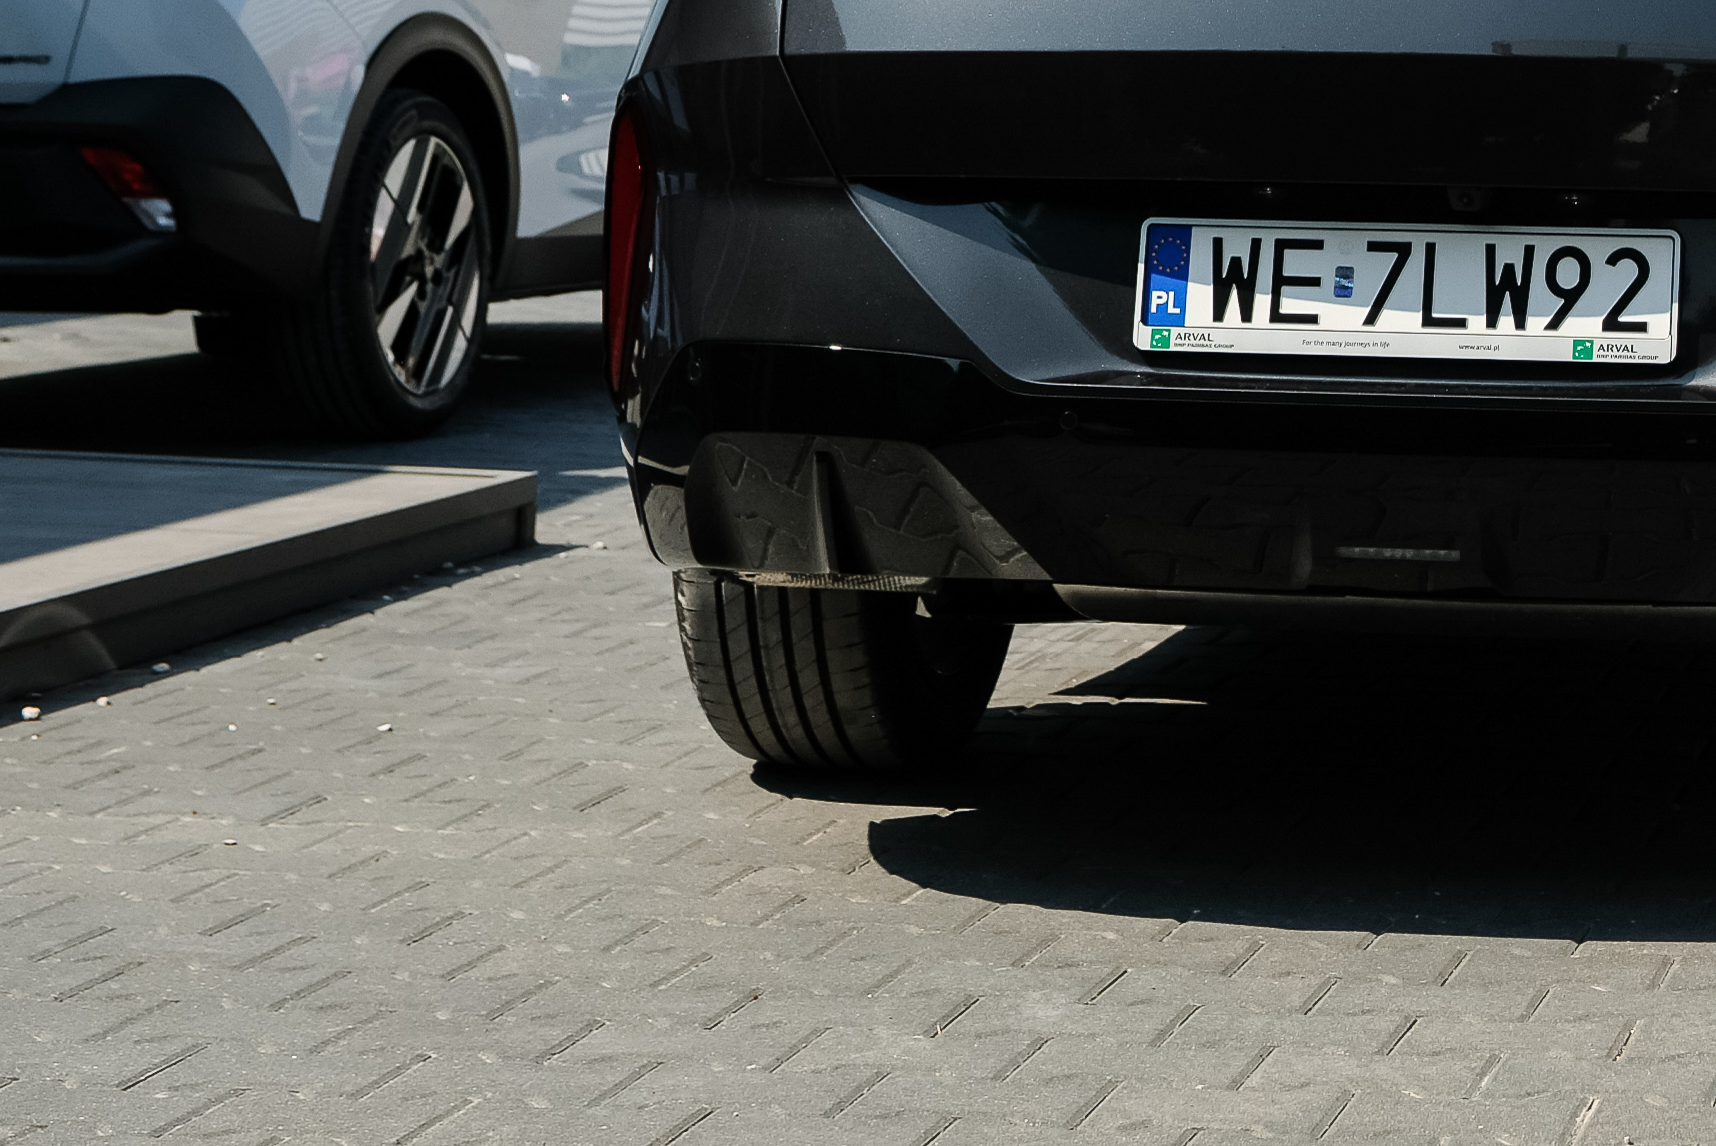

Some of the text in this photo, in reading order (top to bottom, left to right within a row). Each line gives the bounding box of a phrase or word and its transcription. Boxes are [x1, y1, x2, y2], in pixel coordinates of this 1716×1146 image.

[1212, 237, 1651, 333] WE 7LW92
[1150, 290, 1181, 314] PL
[1174, 332, 1214, 342] ARVAL
[1343, 340, 1371, 349] journeys
[1379, 341, 1390, 349] life
[1458, 344, 1500, 352] www.arval.pl
[1597, 343, 1638, 353] ARVAL
